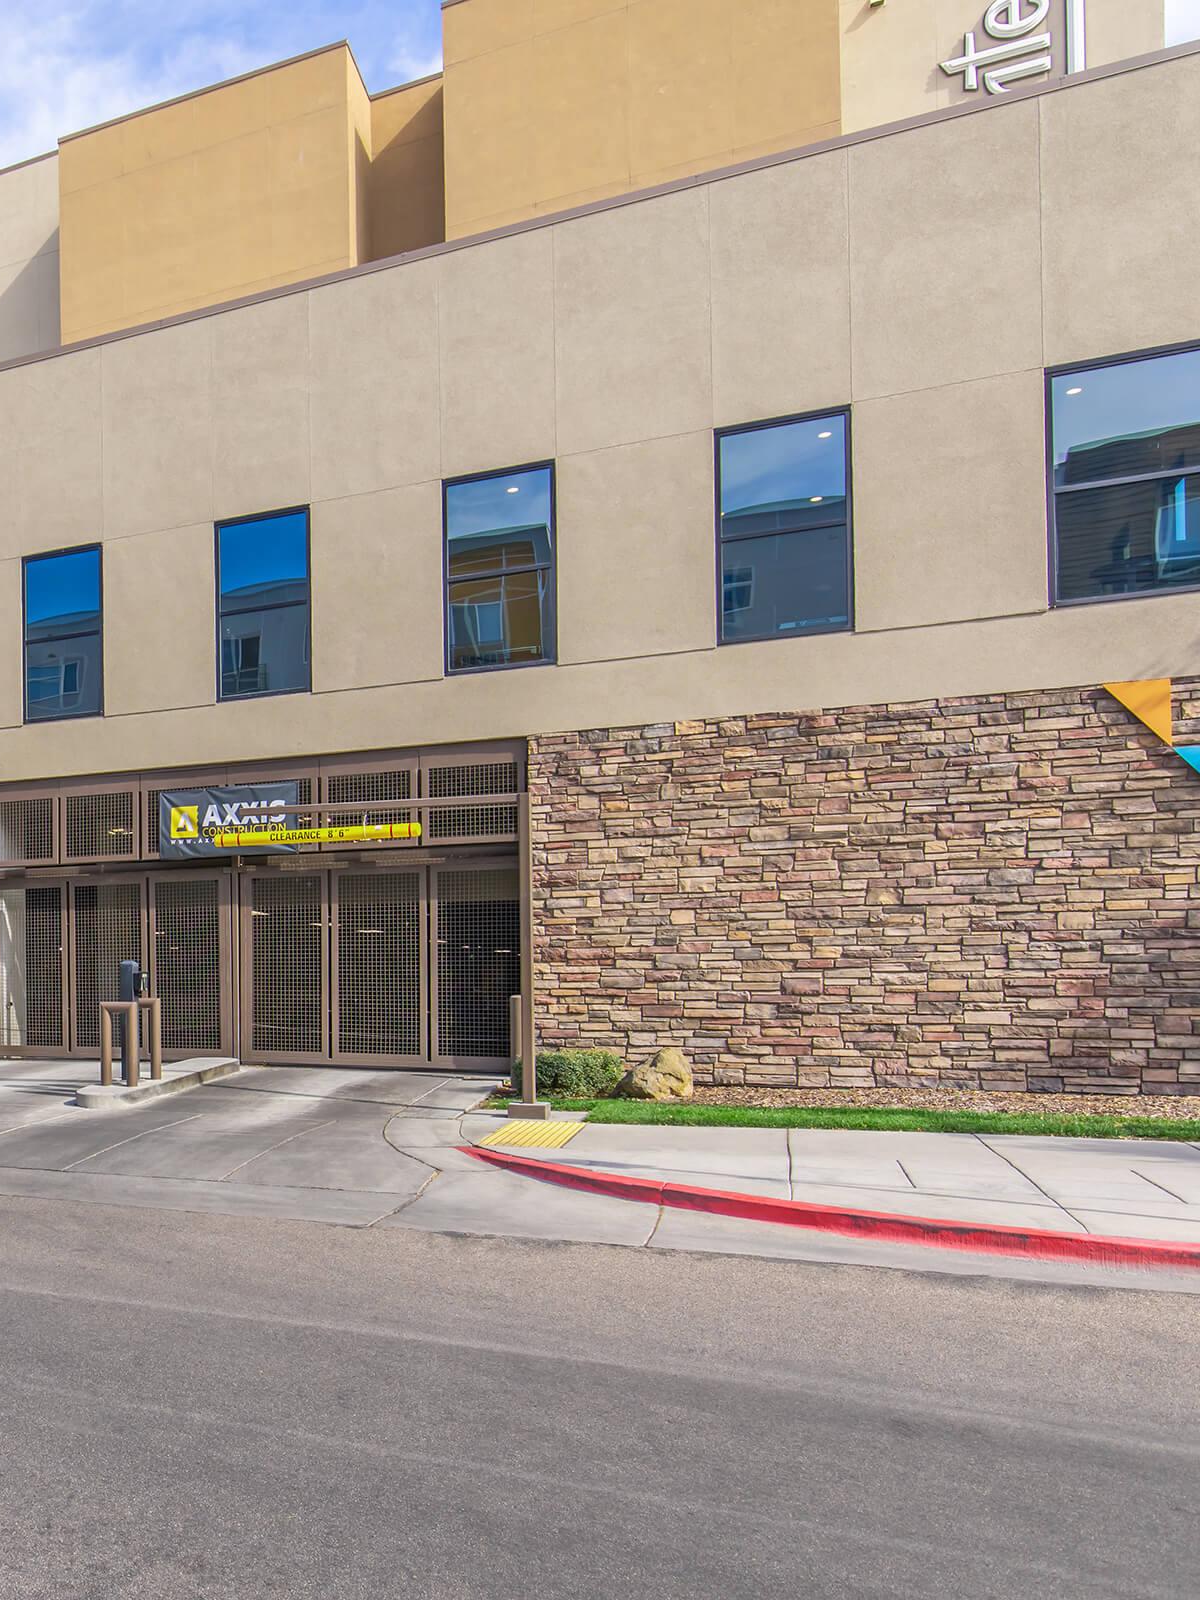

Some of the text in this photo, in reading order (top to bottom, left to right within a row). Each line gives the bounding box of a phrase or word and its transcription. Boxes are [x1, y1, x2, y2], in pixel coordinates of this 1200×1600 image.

[202, 800, 286, 827] AXXIS
[202, 822, 287, 837] CONSTRUCTION
[270, 830, 321, 841] CLEARANCE
